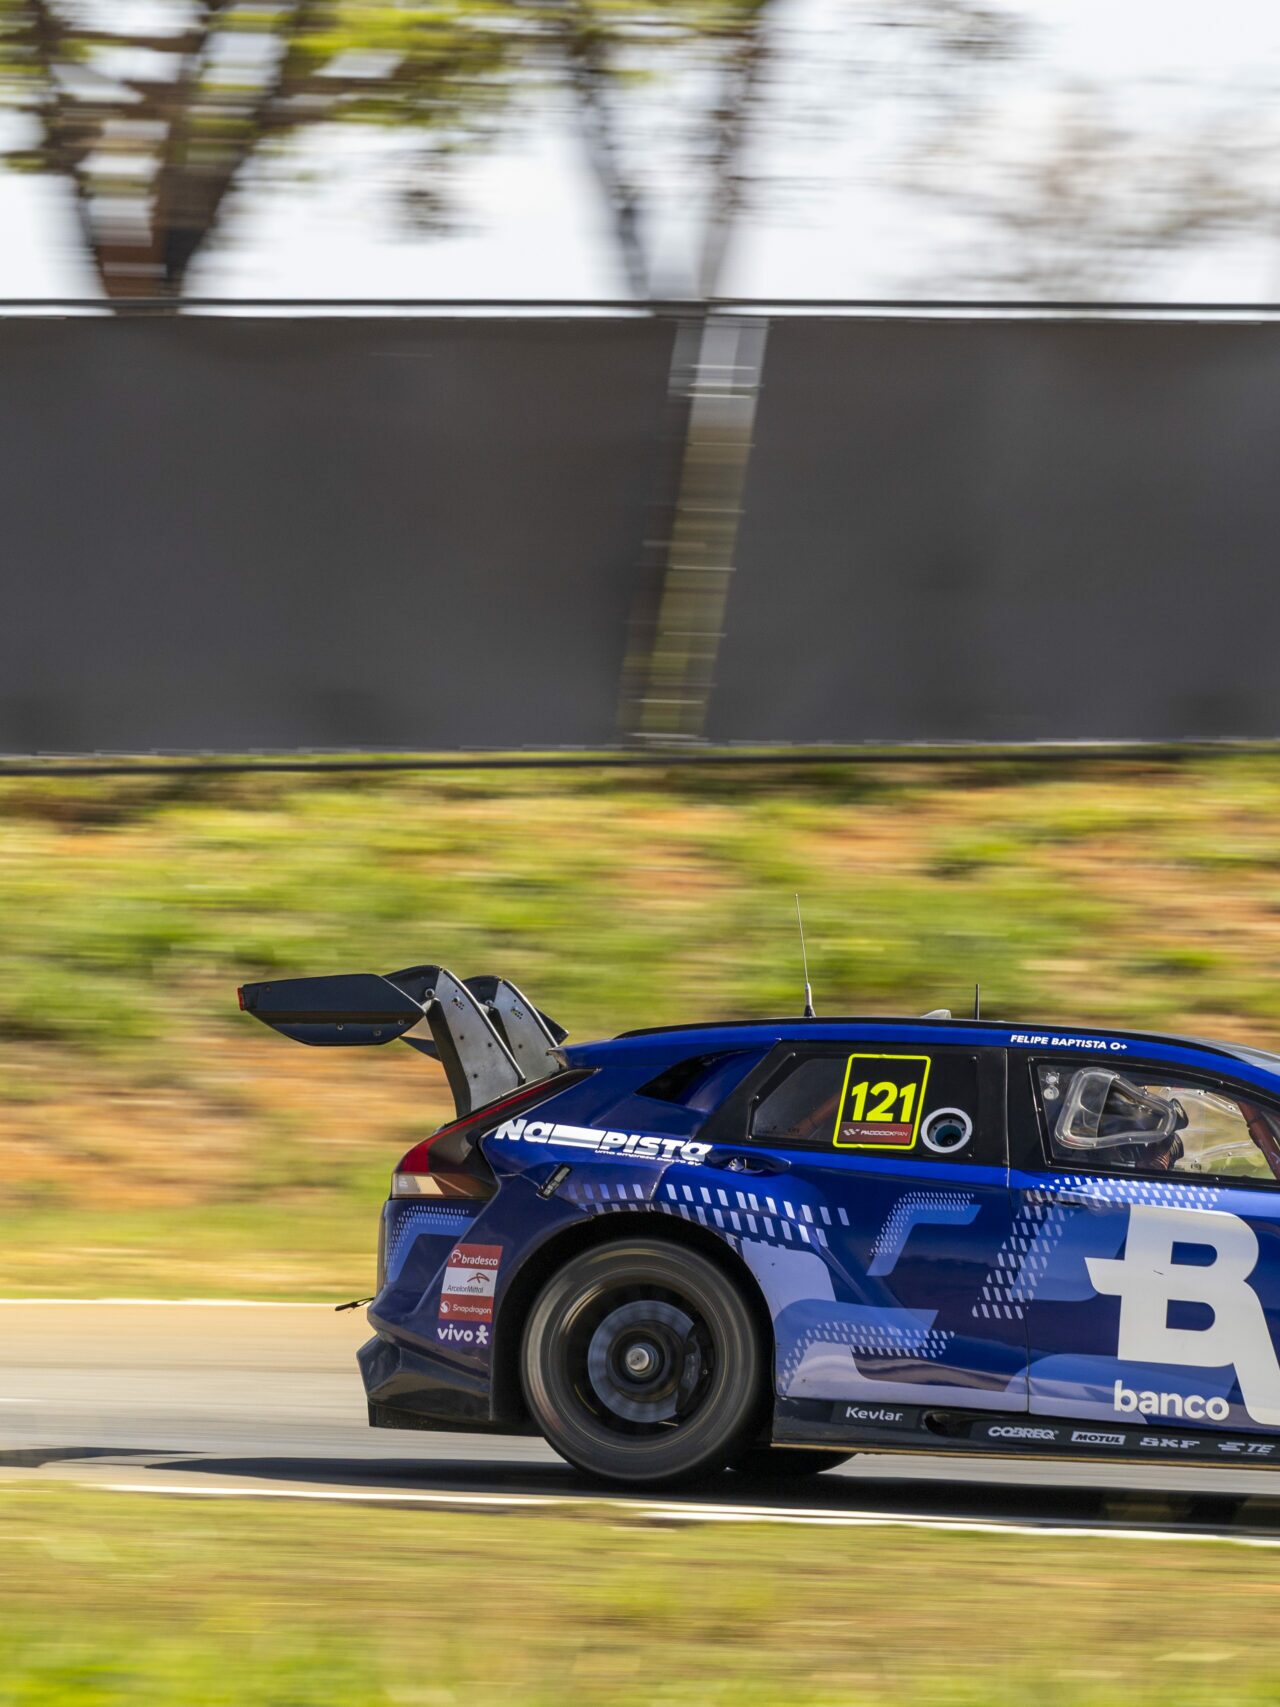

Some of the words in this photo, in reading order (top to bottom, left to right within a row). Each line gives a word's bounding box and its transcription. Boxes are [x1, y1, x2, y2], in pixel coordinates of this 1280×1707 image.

[1010, 1034, 1049, 1045] FELIPE
[1051, 1038, 1107, 1049] BAPTISTA
[851, 1081, 917, 1122] 121
[461, 1254, 499, 1266] bradesco
[446, 1284, 484, 1294] ArcelorMittal
[452, 1303, 492, 1316] Snapdragon
[437, 1323, 474, 1342] vivo
[1113, 1380, 1230, 1421] banco
[845, 1406, 903, 1422] Kevlar
[1074, 1433, 1123, 1445] MOTUL
[1139, 1437, 1200, 1448] SKF
